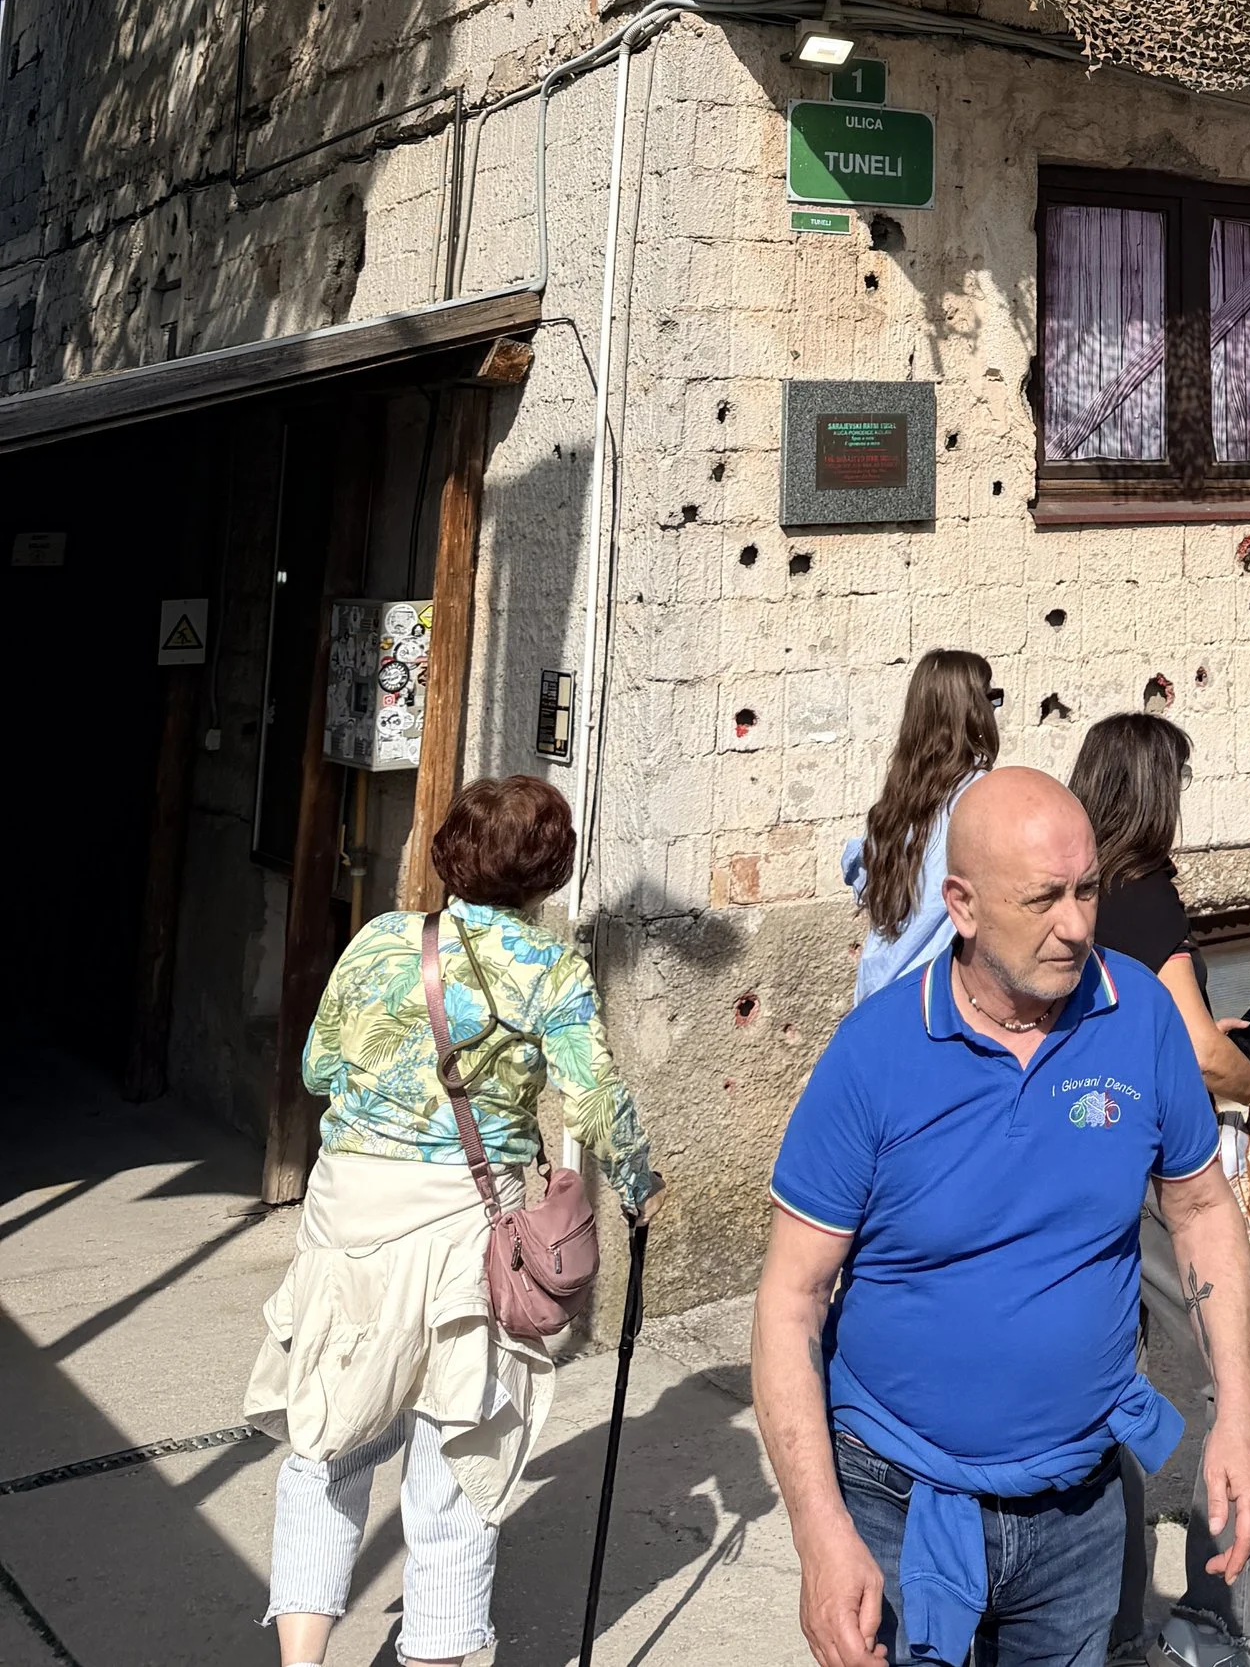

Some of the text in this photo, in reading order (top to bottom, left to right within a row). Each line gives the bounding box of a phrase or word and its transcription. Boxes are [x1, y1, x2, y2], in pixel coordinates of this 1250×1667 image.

[851, 67, 863, 94] 1
[845, 115, 884, 131] ULICA
[824, 151, 903, 178] TUNELI
[1052, 1074, 1142, 1100] I Giovani Dentro
